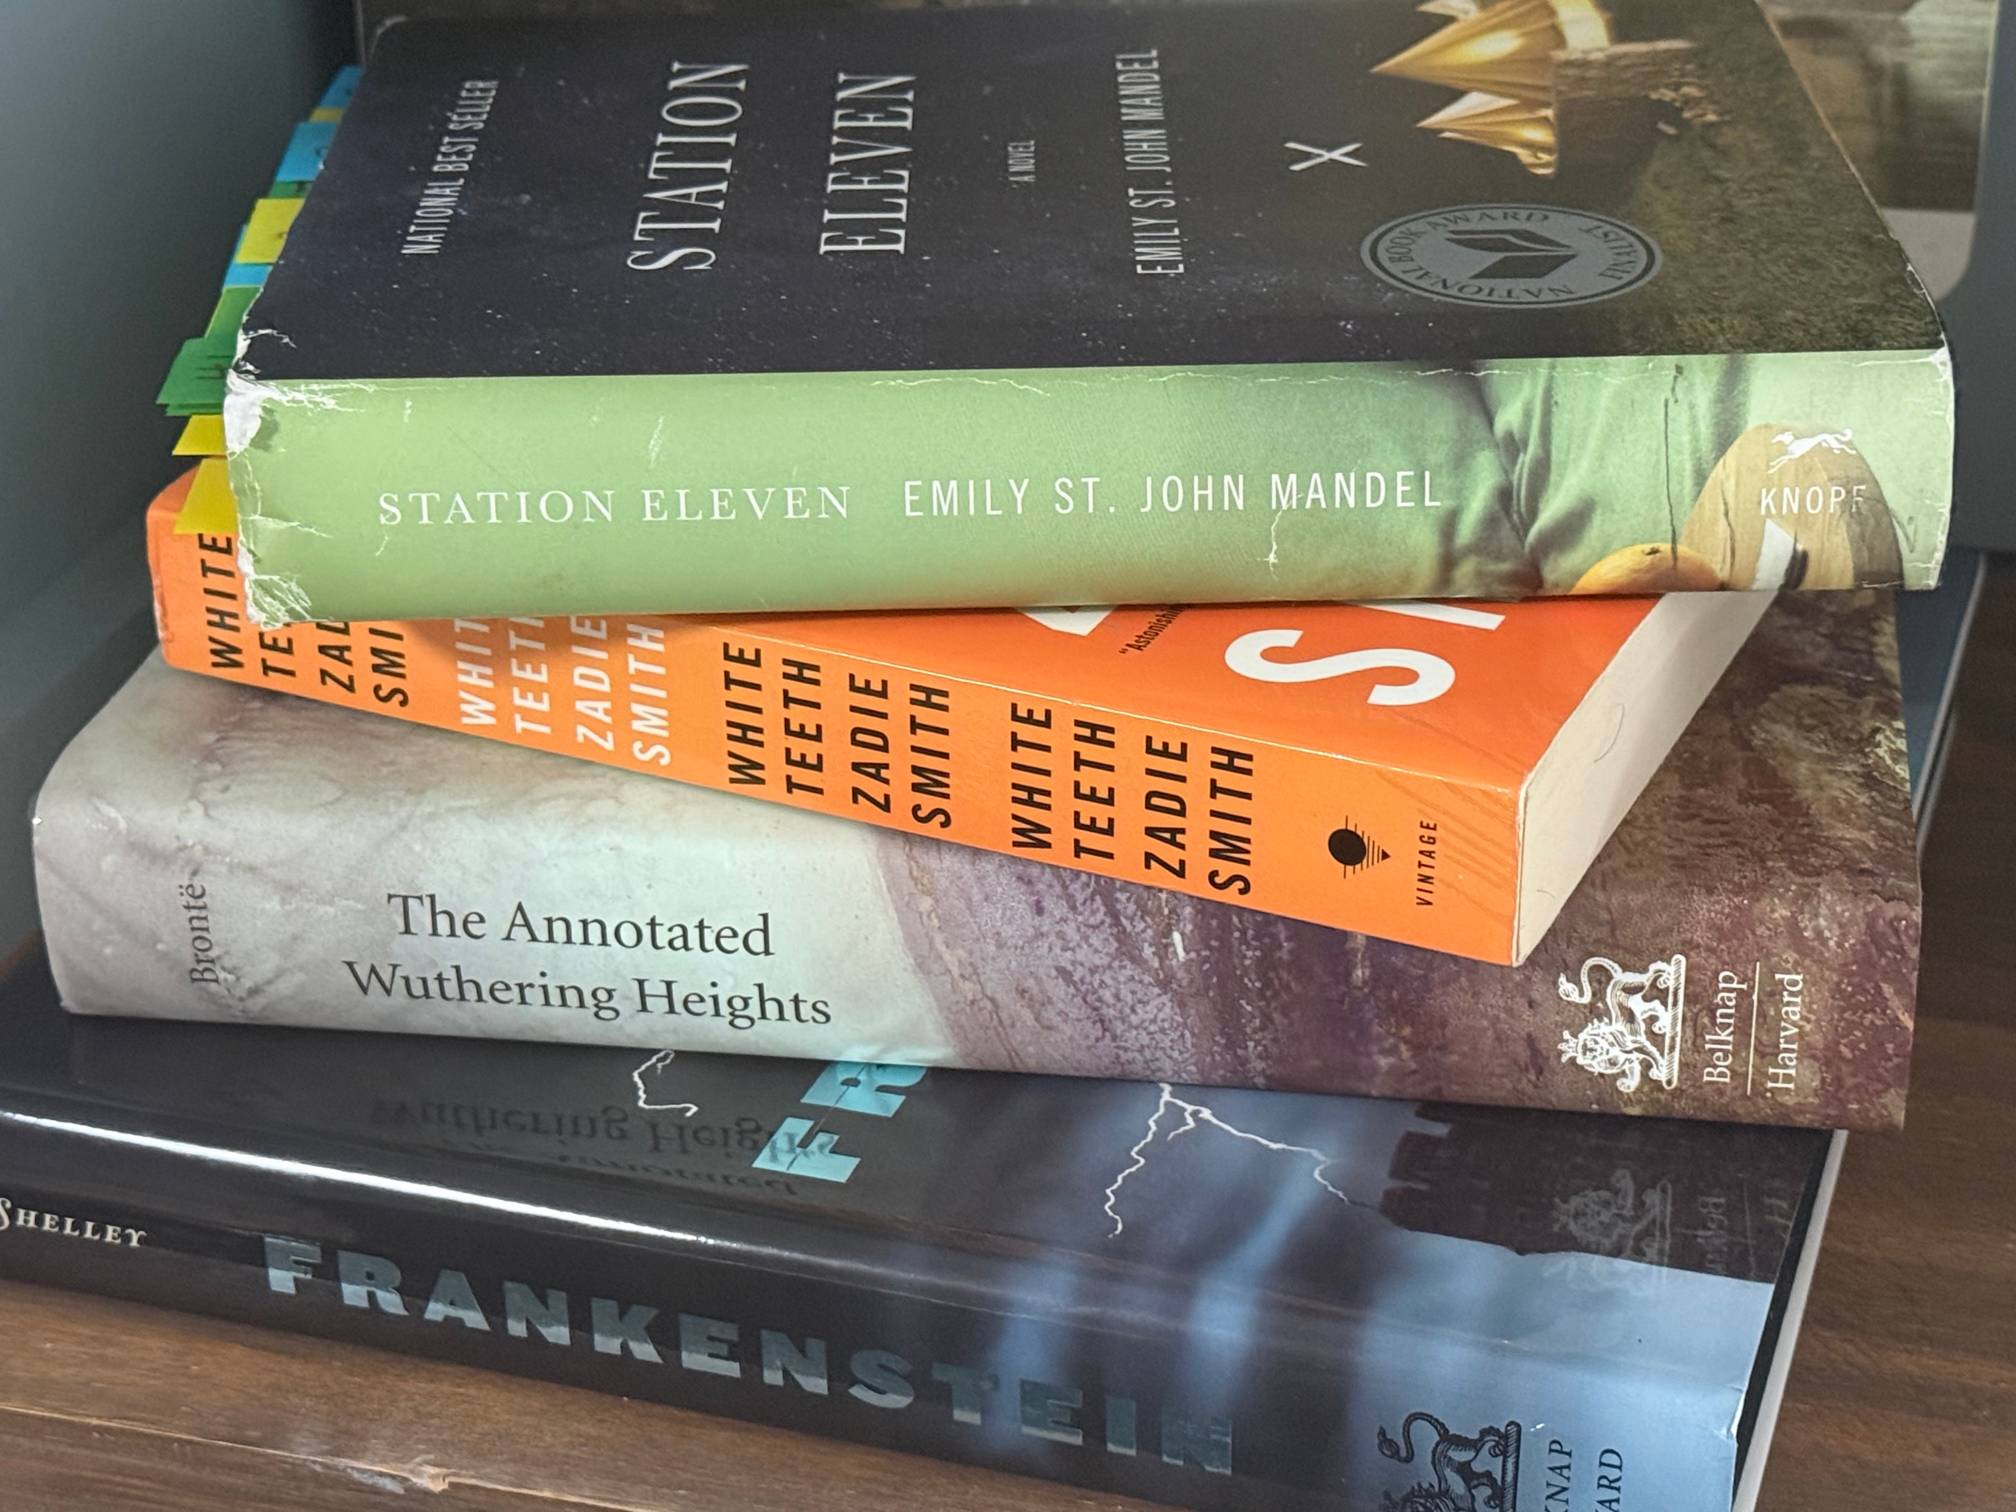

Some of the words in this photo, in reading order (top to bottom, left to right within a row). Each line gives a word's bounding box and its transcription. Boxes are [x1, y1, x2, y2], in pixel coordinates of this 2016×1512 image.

[448, 80, 499, 130] SELLER
[1115, 49, 1165, 121] MANDEL
[432, 136, 479, 172] BEST
[626, 60, 750, 271] STATION
[819, 72, 917, 255] ELEVEN
[1007, 140, 1036, 172] NOVEL
[1008, 174, 1037, 182] A
[1122, 129, 1172, 173] JOHN
[400, 178, 465, 254] NATIONAL
[1128, 180, 1176, 208] ST.
[1424, 210, 1550, 232] AWARD
[1131, 216, 1184, 274] EMILY
[1385, 225, 1427, 264] BOOK
[1401, 262, 1577, 299] NATIONAL
[1577, 223, 1639, 281] FINALIST
[378, 489, 615, 525] STATION
[641, 486, 851, 522] ELEVEN
[903, 478, 1030, 517] EMILY
[1054, 476, 1116, 514] ST.
[1140, 474, 1246, 514] JOHN
[1270, 470, 1443, 511] MANDEL
[1759, 485, 1867, 516] KNOPF
[198, 533, 244, 669] WHITE
[259, 622, 297, 678] TE
[570, 615, 615, 752] ZADIE
[626, 623, 671, 766] SMITH
[723, 642, 766, 785] WHITE
[782, 658, 824, 796] TEETH
[849, 672, 891, 814] ZADIE
[909, 683, 952, 829] SMITH
[1011, 702, 1052, 849] WHITE
[1073, 719, 1115, 860] TEETH
[1144, 735, 1188, 879] ZADIE
[1208, 746, 1254, 895] SMITH
[1416, 820, 1438, 906] VINTAGE
[178, 883, 220, 984] Brontë
[387, 893, 488, 940] The
[502, 900, 775, 957] Annotated
[342, 959, 619, 1022] Wuthering
[631, 977, 832, 1031] Heights
[1703, 970, 1748, 1083] Belknap
[1767, 973, 1804, 1090] Harvard
[263, 1233, 1232, 1475] FRANKENSTEIN
[1544, 1439, 1572, 1512] NAP
[1595, 1448, 1623, 1512] ARD
